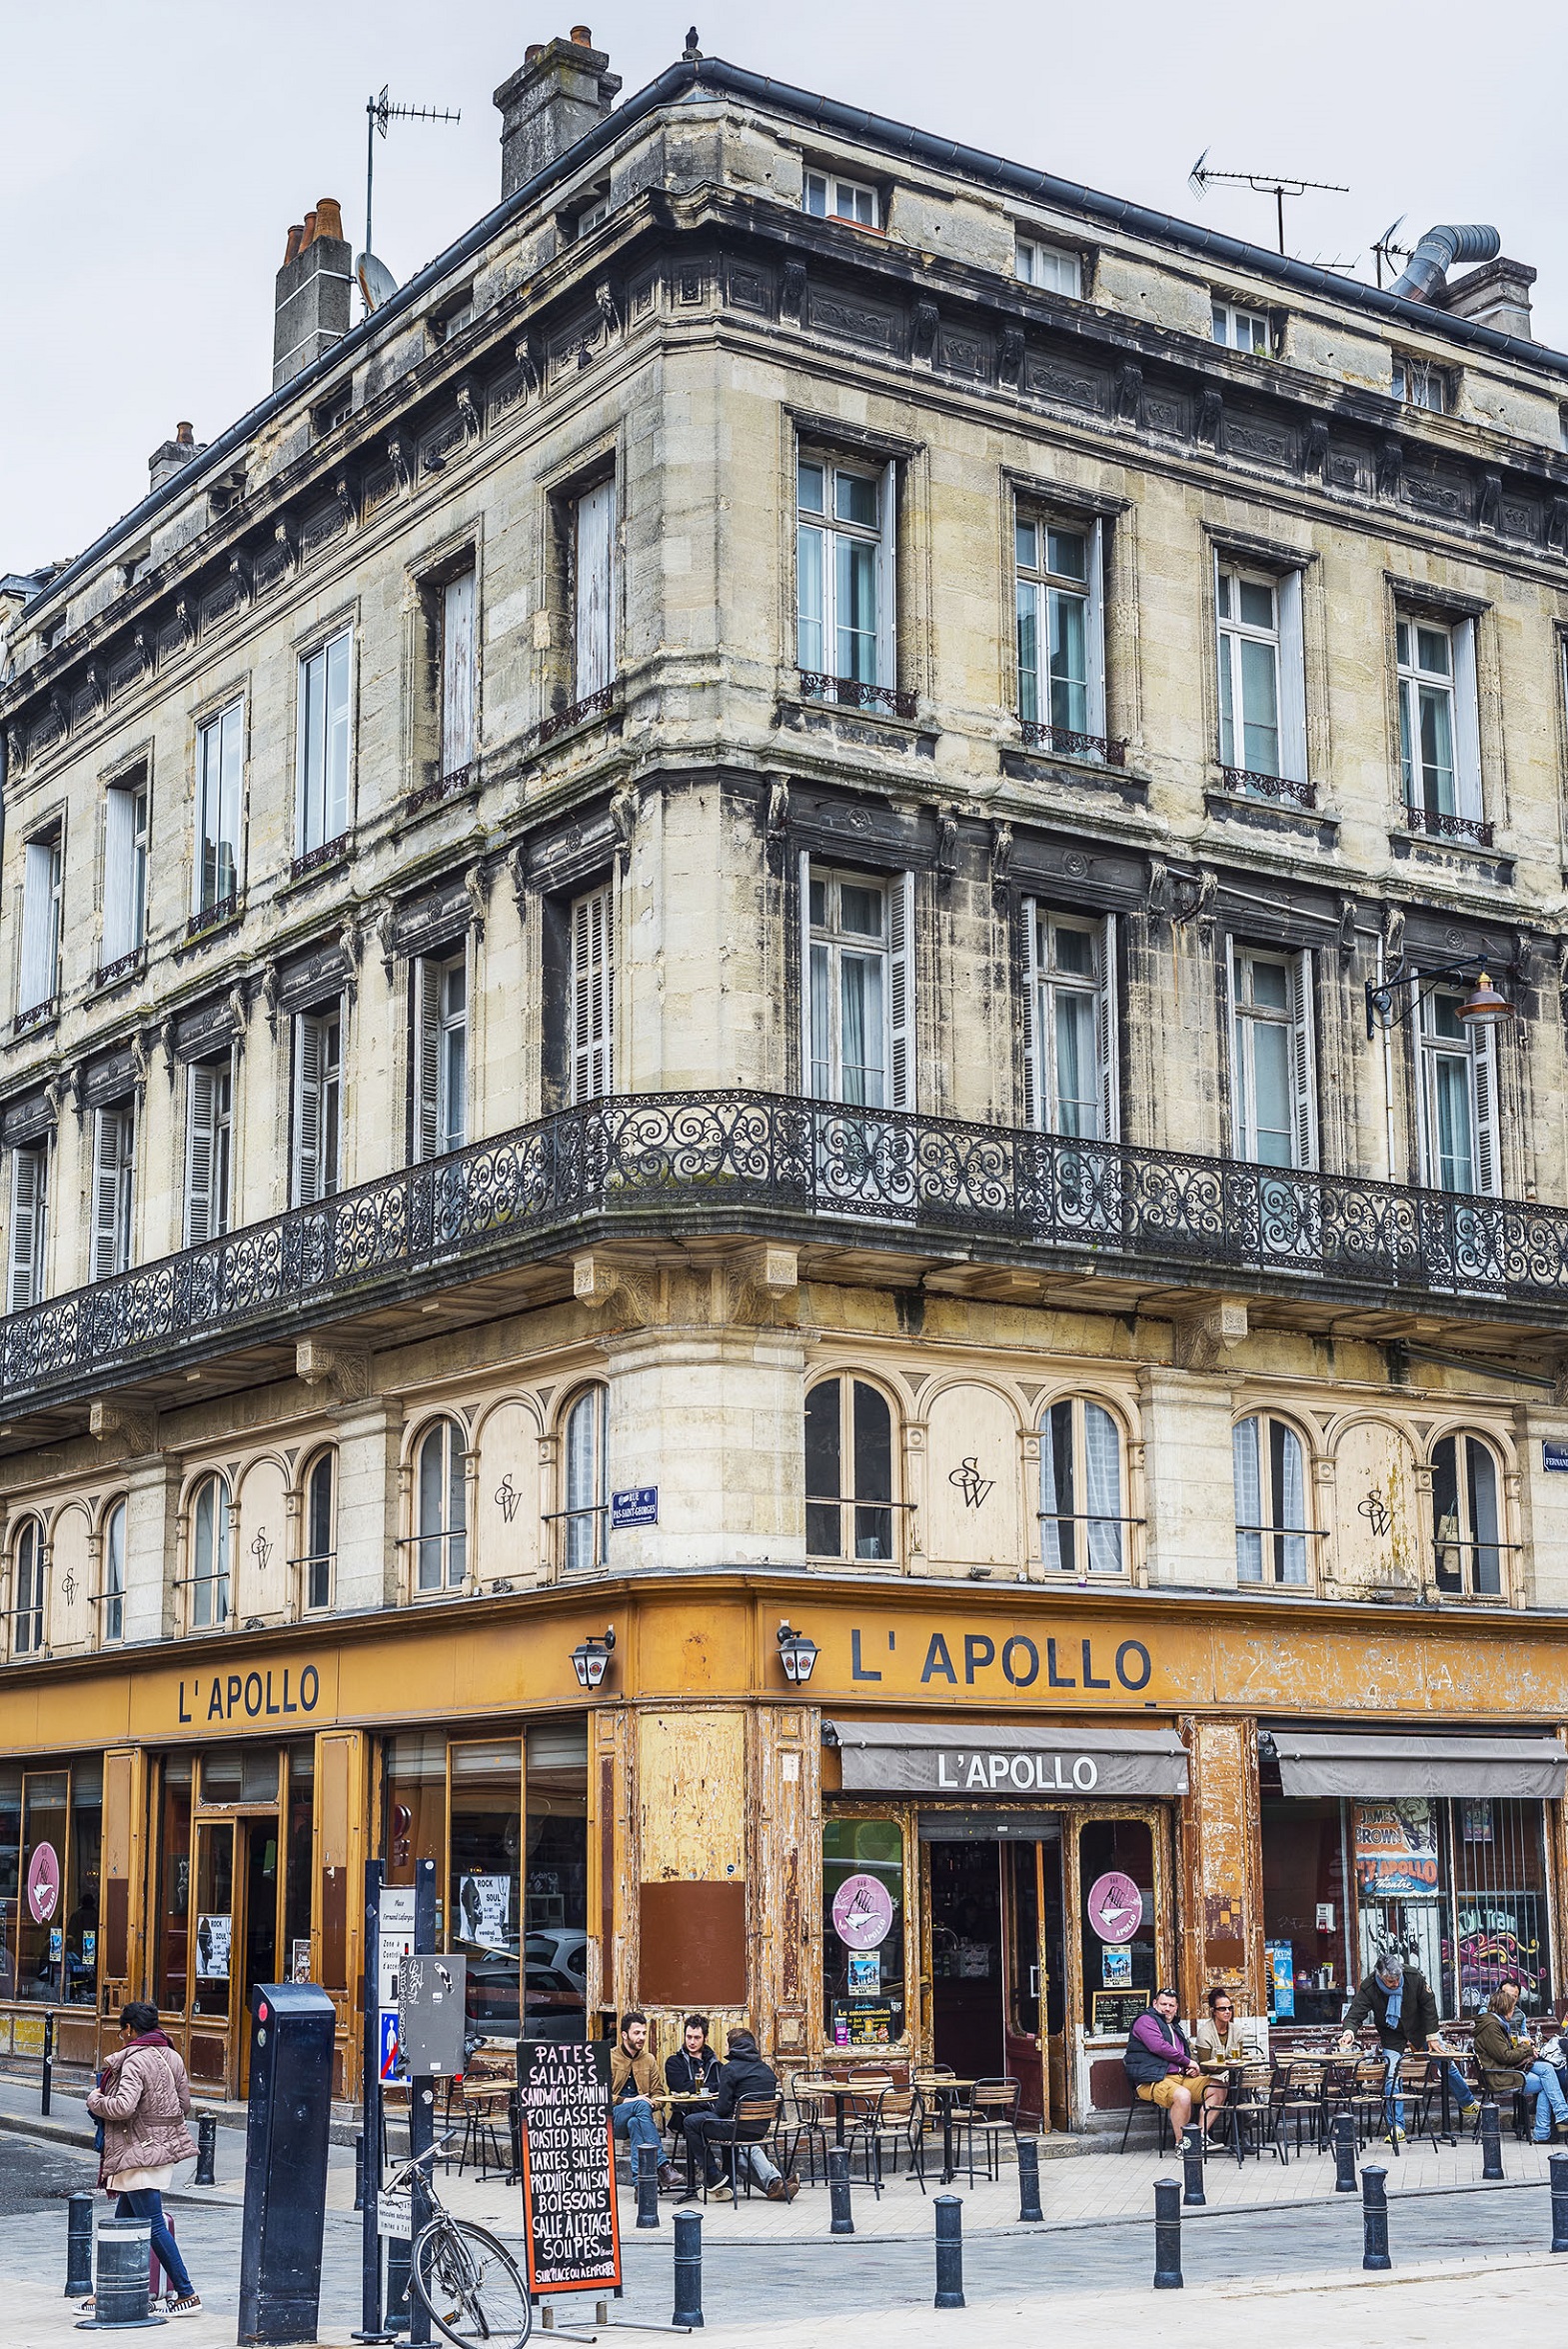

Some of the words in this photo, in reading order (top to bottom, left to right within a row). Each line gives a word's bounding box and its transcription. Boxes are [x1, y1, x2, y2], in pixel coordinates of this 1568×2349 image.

[630, 1492, 640, 1501] RUE
[938, 1754, 1097, 1791] L'APOLLO
[1360, 1809, 1397, 1824] JAMES
[1356, 1827, 1402, 1845] BROWN
[1380, 1860, 1437, 1884] APOLLO
[477, 1879, 494, 1888] ROCK
[486, 1893, 502, 1902] SOUL
[862, 1918, 886, 1944] APOLLO
[1115, 1913, 1138, 1938] APOLLO
[535, 2044, 595, 2064] PATES
[530, 2065, 598, 2085] SALADES
[527, 2106, 606, 2127] FOUGASSES
[528, 2129, 570, 2150] TOASTED
[571, 2127, 608, 2148] BURGER
[530, 2150, 569, 2171] TARTES
[572, 2146, 609, 2168] SALÉES
[533, 2214, 563, 2239] SALLE
[565, 2210, 574, 2238] À
[543, 2236, 600, 2260] SOUPES
[536, 2269, 551, 2283] SUR
[551, 2267, 571, 2282] PLACE
[571, 2268, 580, 2280] OU
[586, 2261, 616, 2278] EMPORTER
